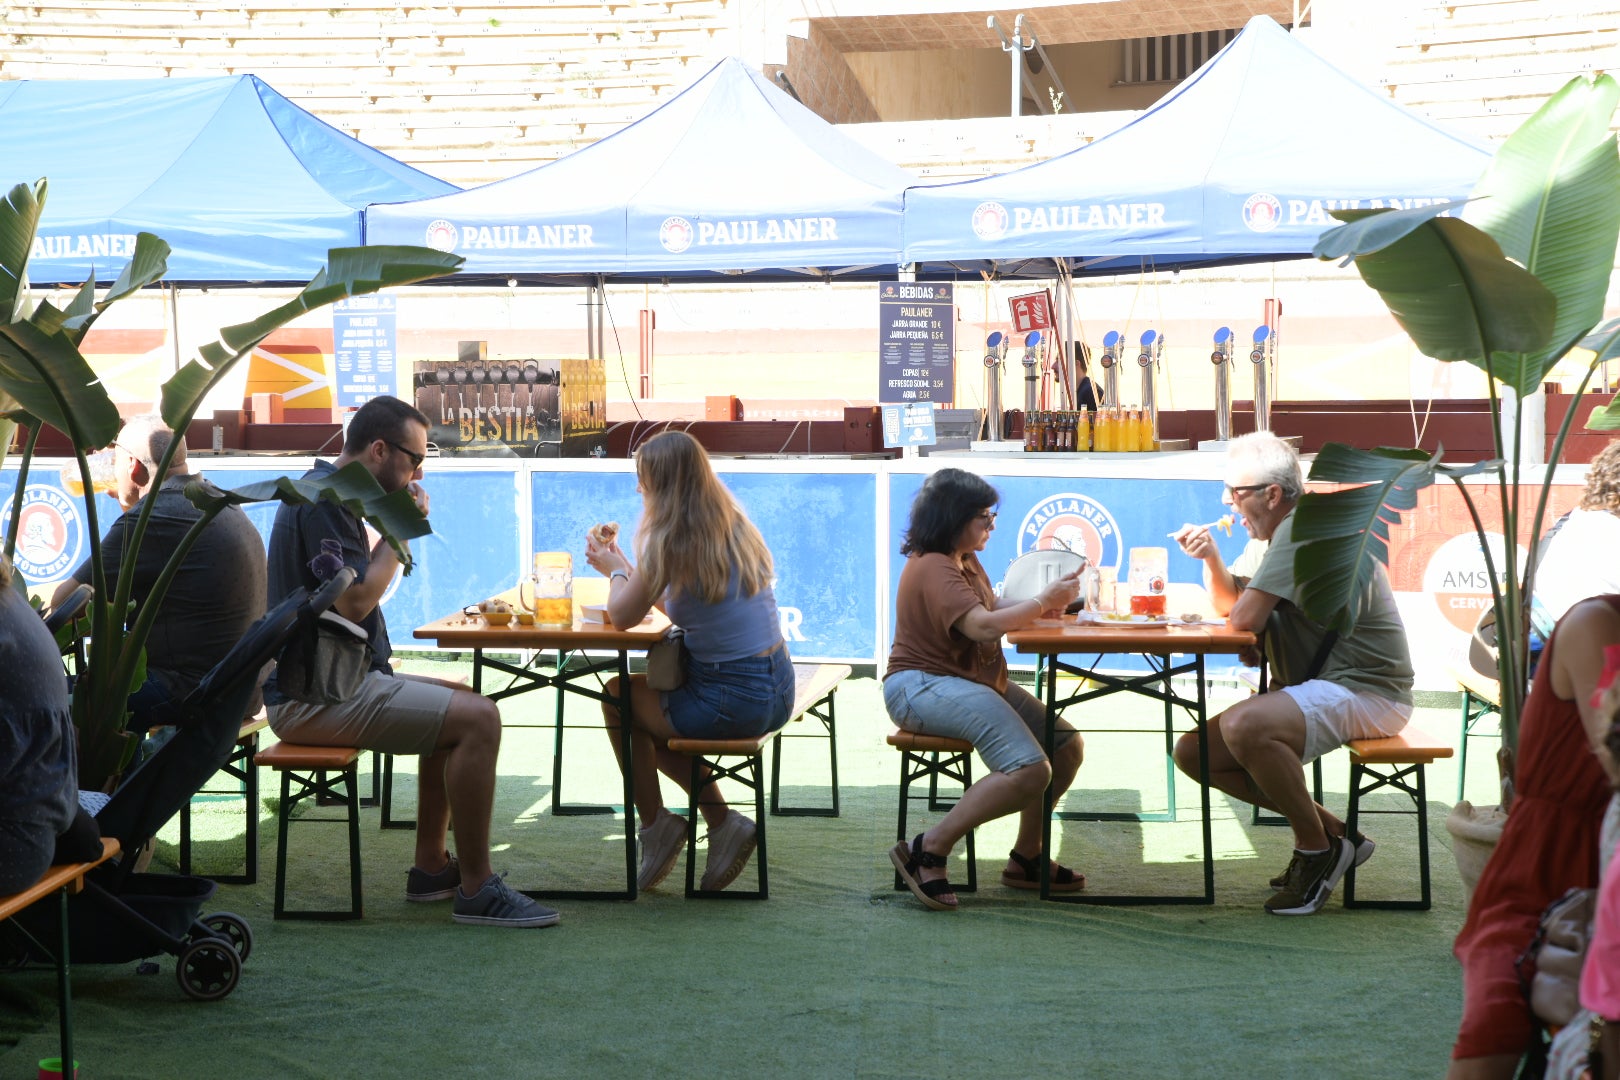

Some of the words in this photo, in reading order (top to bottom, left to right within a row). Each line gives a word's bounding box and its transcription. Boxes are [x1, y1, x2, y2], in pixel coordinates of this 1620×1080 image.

[1013, 203, 1166, 233] PAULANER
[461, 224, 595, 249] PAULANER
[697, 217, 839, 246] PAULANER
[29, 234, 137, 259] AULANER
[900, 286, 933, 299] BEBIDAS
[900, 307, 933, 317] PAULANER
[891, 319, 908, 328] JARRA
[909, 320, 928, 328] GRANDE
[890, 330, 906, 339] JARRA
[906, 330, 928, 340] PEQUEÑA
[902, 368, 919, 377] COPAS
[888, 379, 913, 388] REFRESCO
[902, 390, 916, 399] AGUA
[441, 406, 455, 425] LA
[459, 405, 539, 442] BESTIA
[1026, 500, 1113, 539] PAULANER
